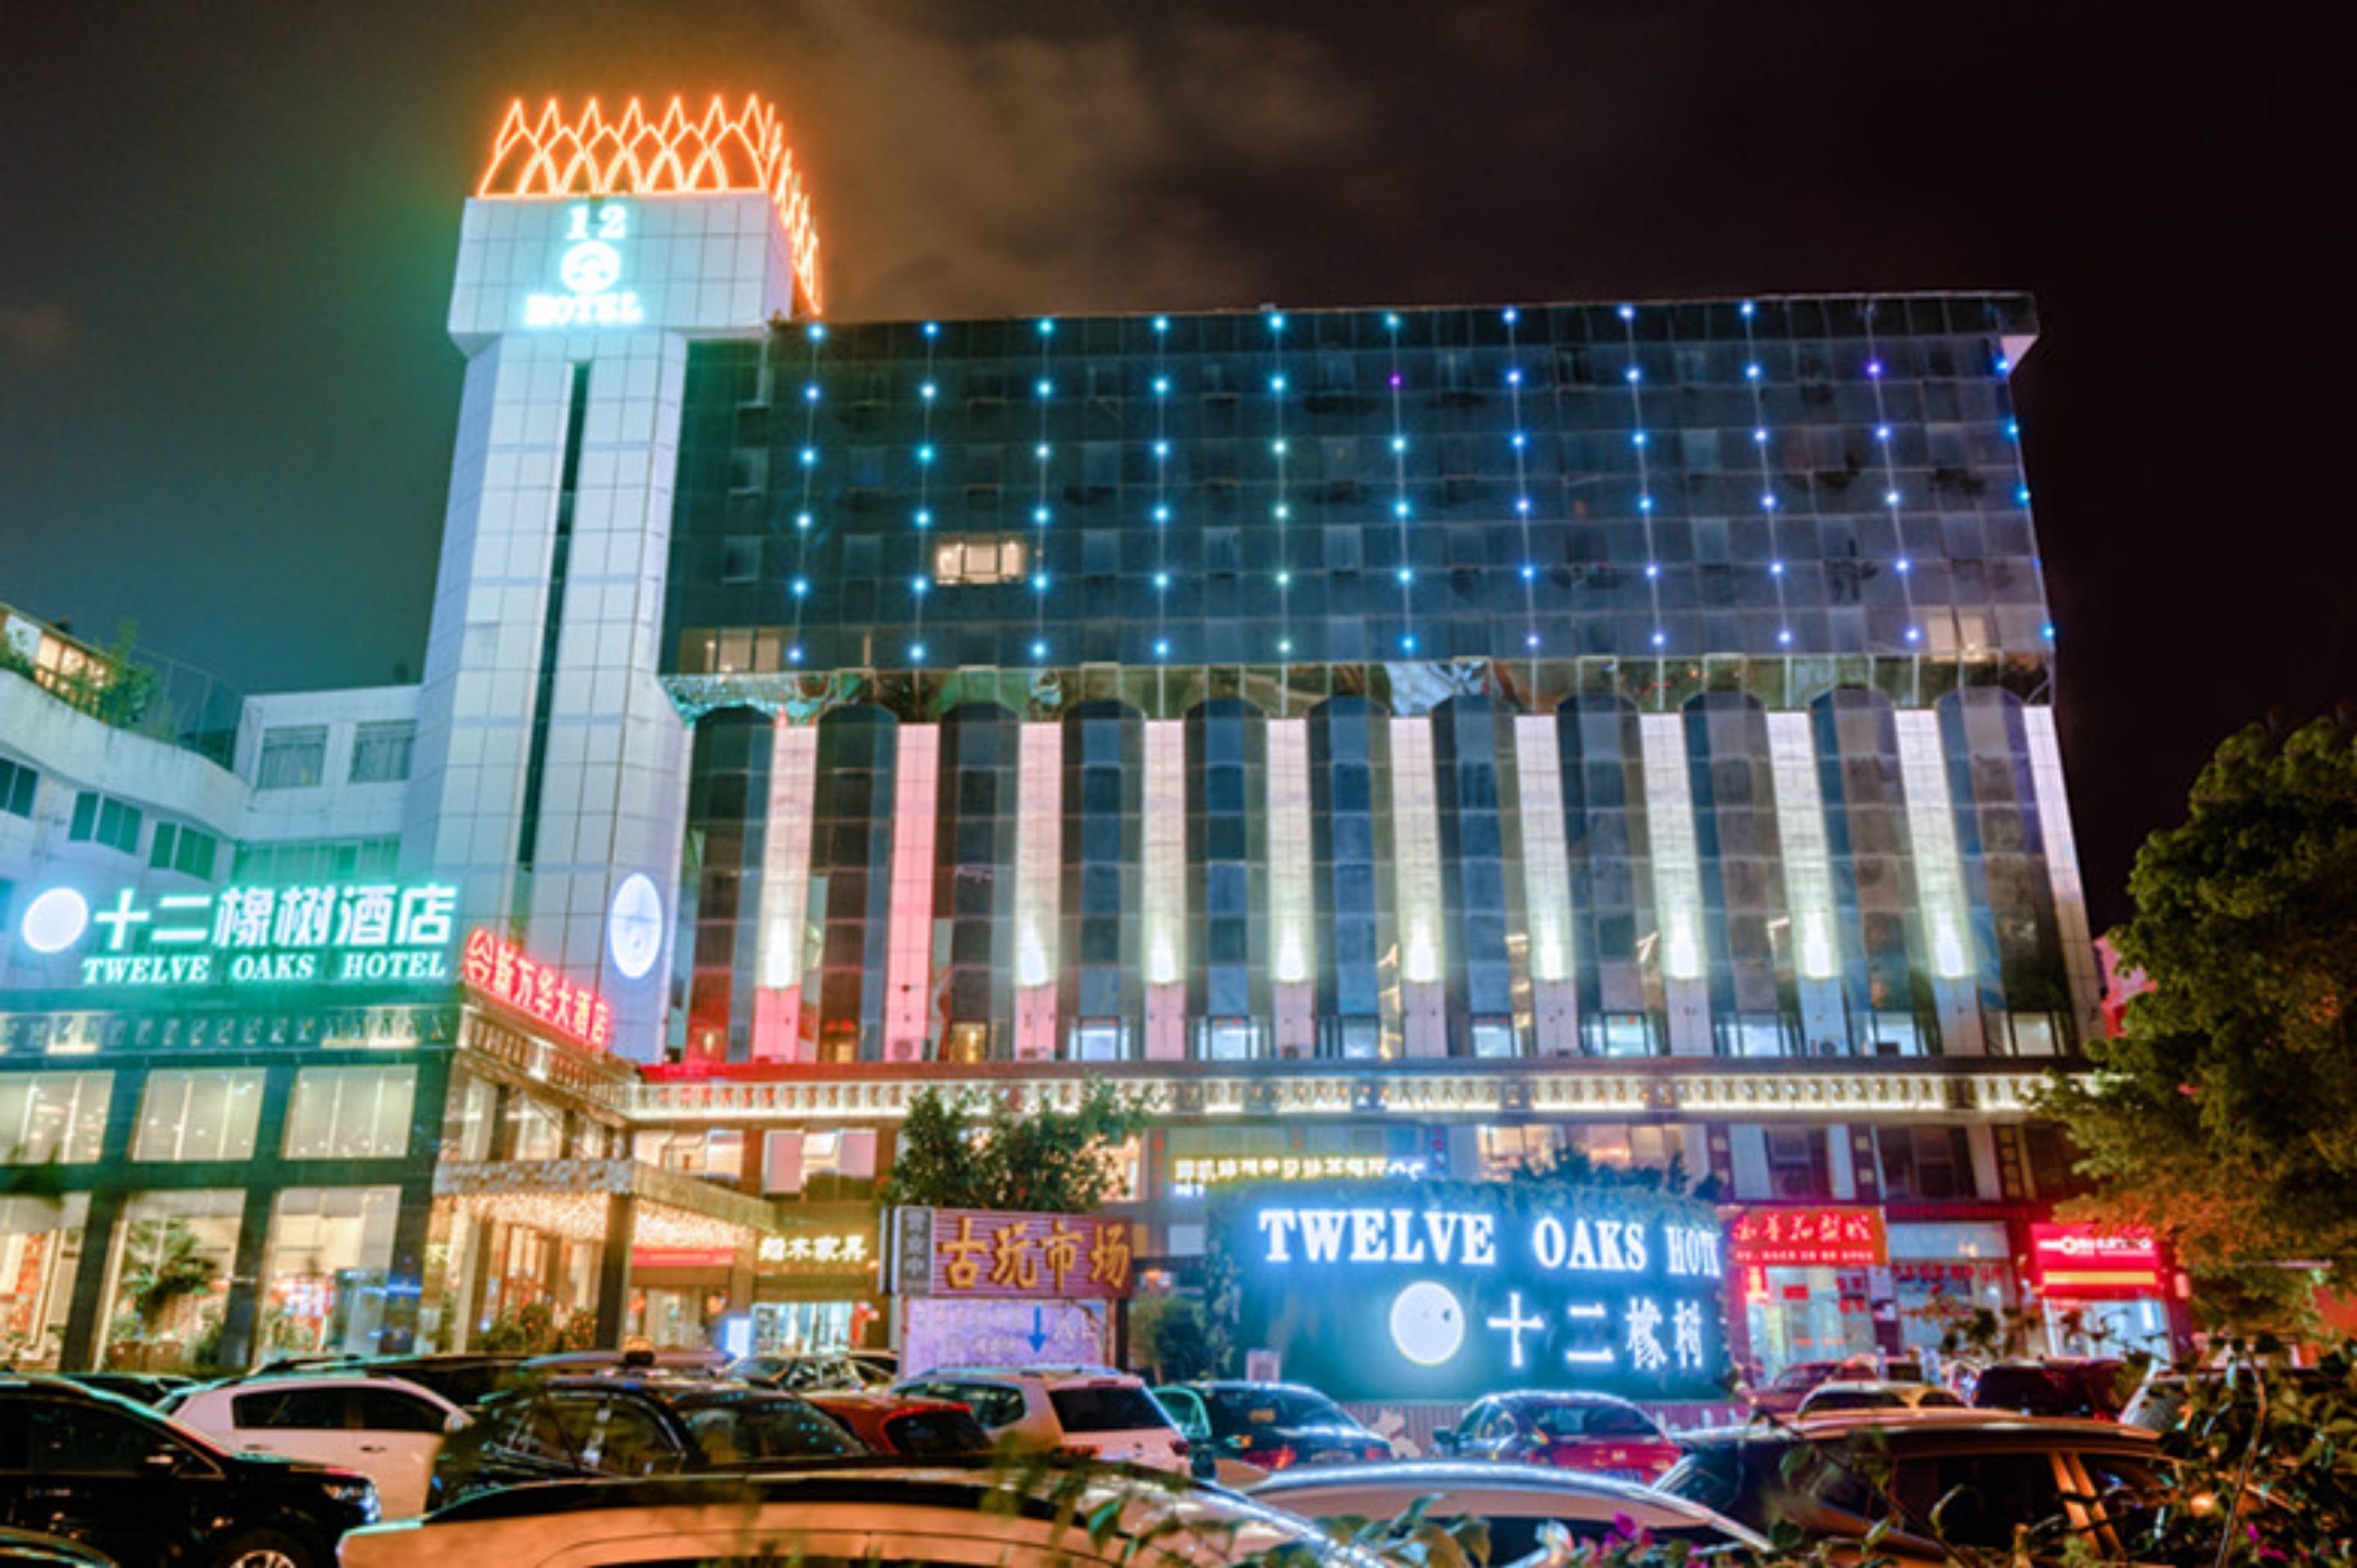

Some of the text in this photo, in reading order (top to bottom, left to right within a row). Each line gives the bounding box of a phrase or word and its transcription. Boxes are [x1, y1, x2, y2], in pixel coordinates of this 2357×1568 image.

[565, 204, 628, 240] 12
[524, 291, 642, 327] HOTEL
[93, 884, 457, 949] 十二橡树酒店
[83, 951, 446, 984] TWELVE OAKS HOTEL
[937, 1215, 1129, 1291] 古玩市场
[1259, 1208, 1496, 1266] TWELVE
[1533, 1217, 1648, 1273] OAKS
